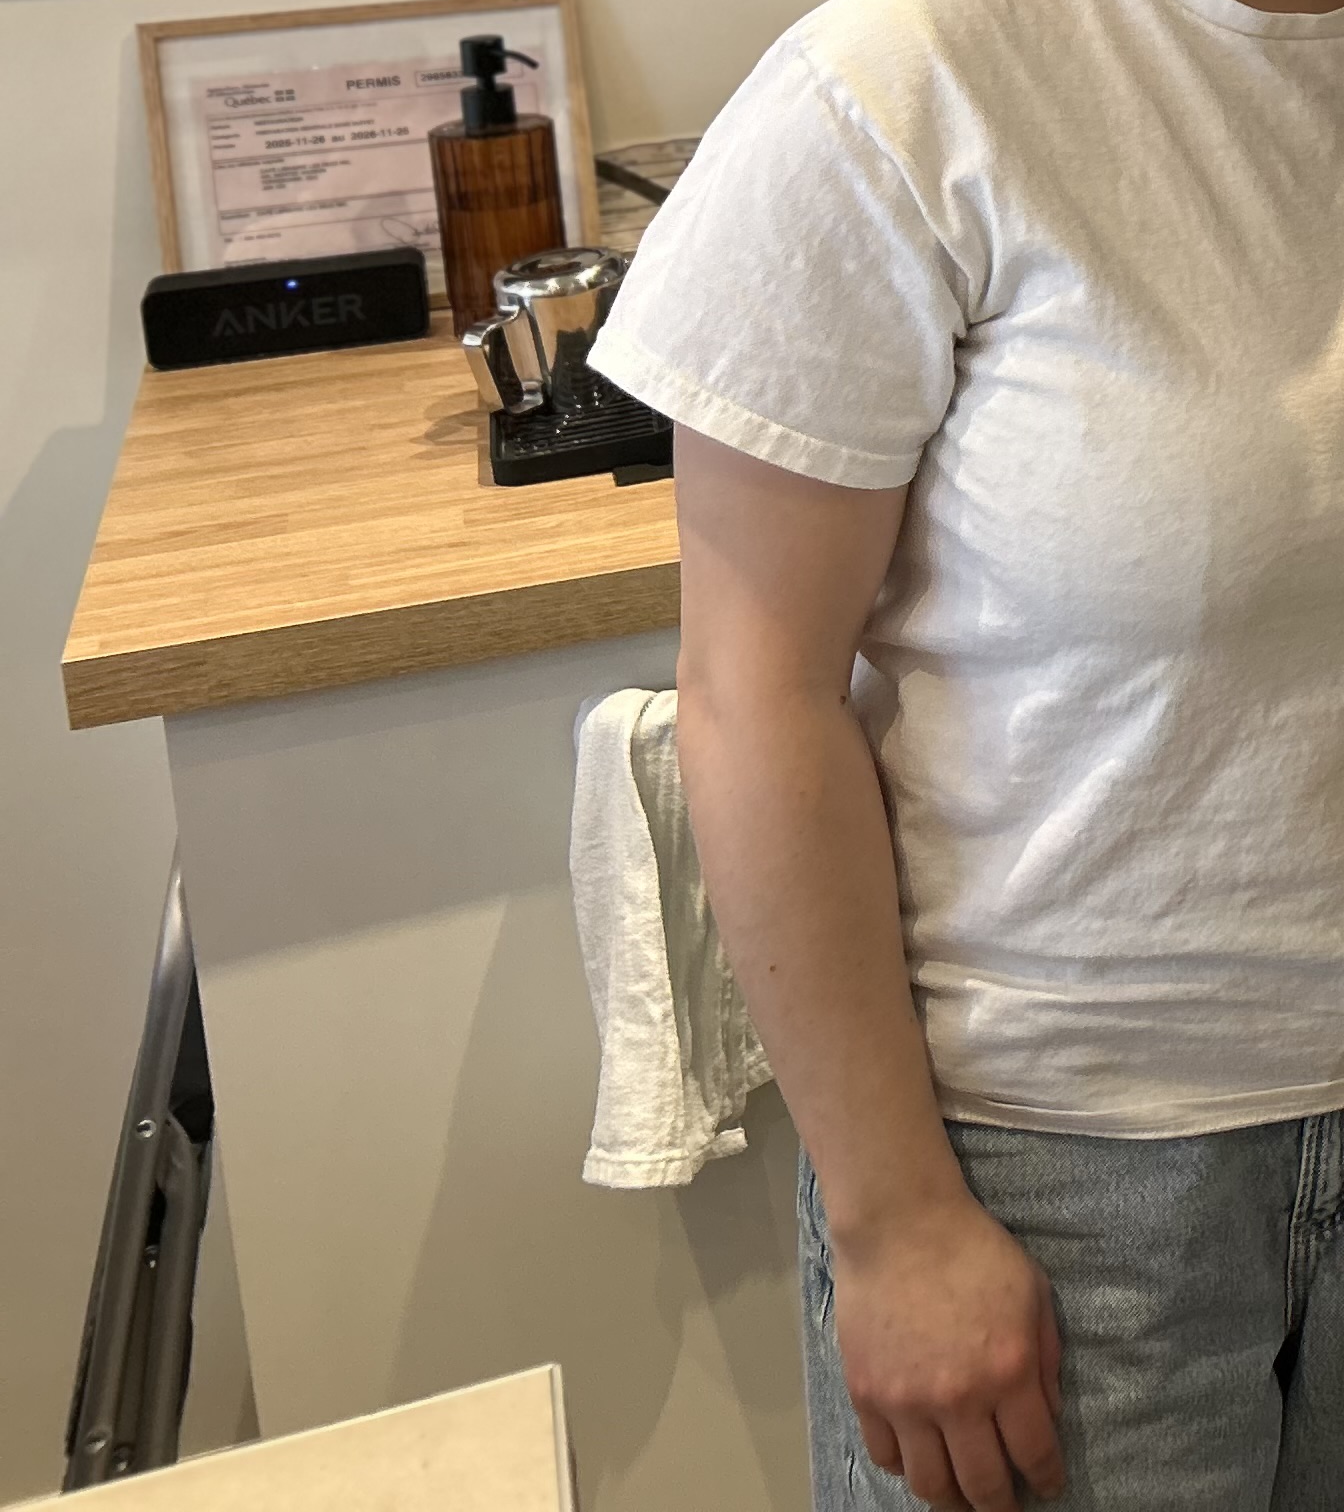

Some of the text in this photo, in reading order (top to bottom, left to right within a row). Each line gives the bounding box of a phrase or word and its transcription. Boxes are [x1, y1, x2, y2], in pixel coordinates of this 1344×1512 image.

[345, 73, 401, 91] PERMIS
[224, 90, 273, 109] Québec
[212, 293, 366, 339] ANKER
